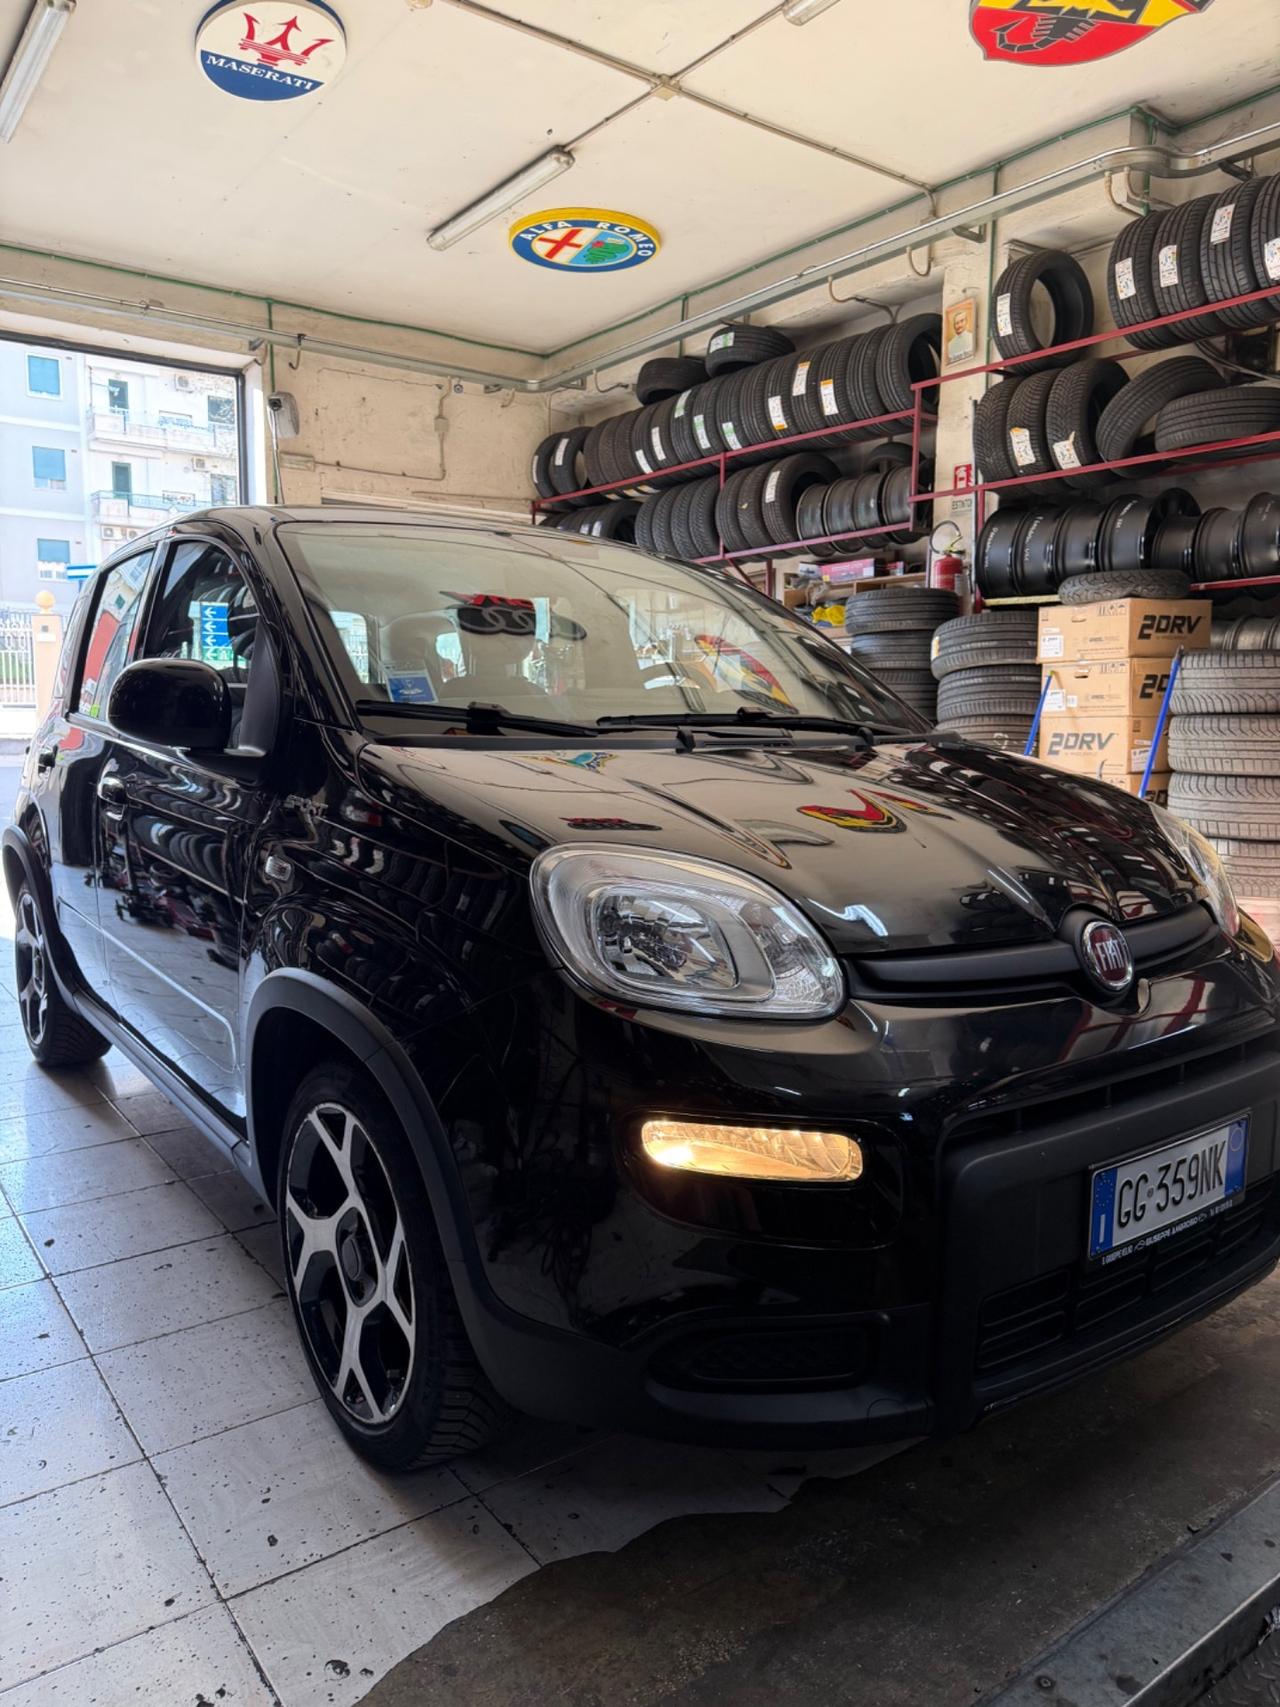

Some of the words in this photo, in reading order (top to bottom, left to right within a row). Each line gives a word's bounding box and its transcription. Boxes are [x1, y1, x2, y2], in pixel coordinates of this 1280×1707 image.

[206, 55, 313, 90] MASERATI
[519, 221, 572, 240] ALFA
[596, 222, 654, 257] ROMEO
[1095, 937, 1125, 971] FIAT
